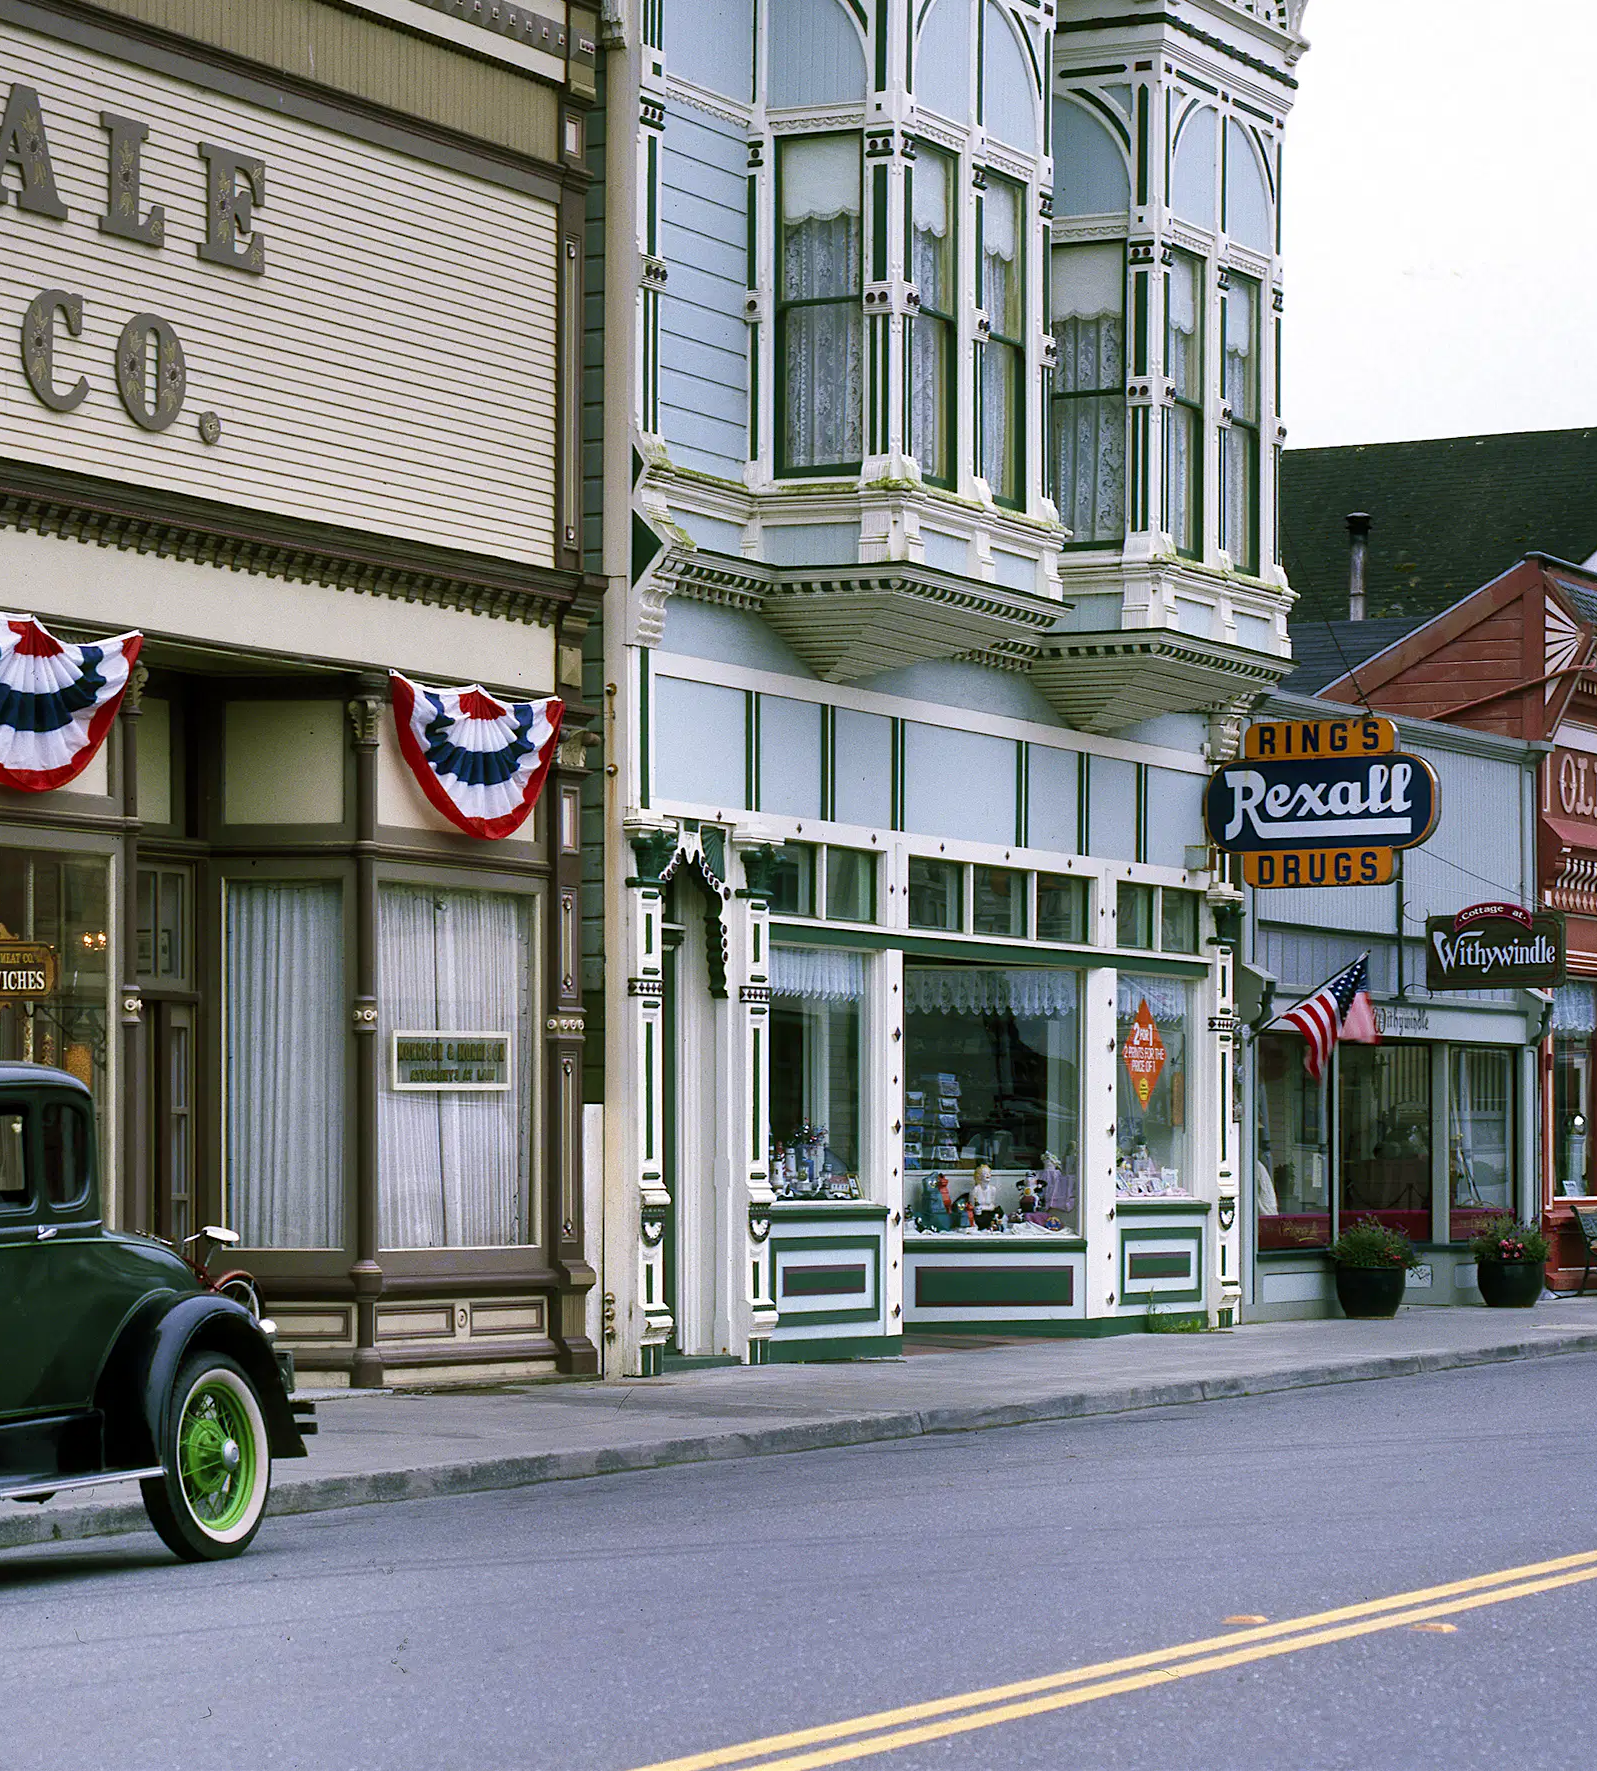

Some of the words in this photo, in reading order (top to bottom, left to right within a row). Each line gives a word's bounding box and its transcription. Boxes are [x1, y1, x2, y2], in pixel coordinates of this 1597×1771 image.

[20, 288, 222, 446] CO.
[1258, 720, 1380, 755] RING'S
[1224, 763, 1413, 841] Rexall
[1258, 851, 1378, 886] DRUGS
[1461, 905, 1504, 920] Cottage
[1512, 909, 1524, 919] at
[0, 952, 20, 963] MEAT
[1432, 930, 1556, 976] Withywindle
[1133, 1022, 1140, 1046] 2
[1148, 1023, 1153, 1046] 1
